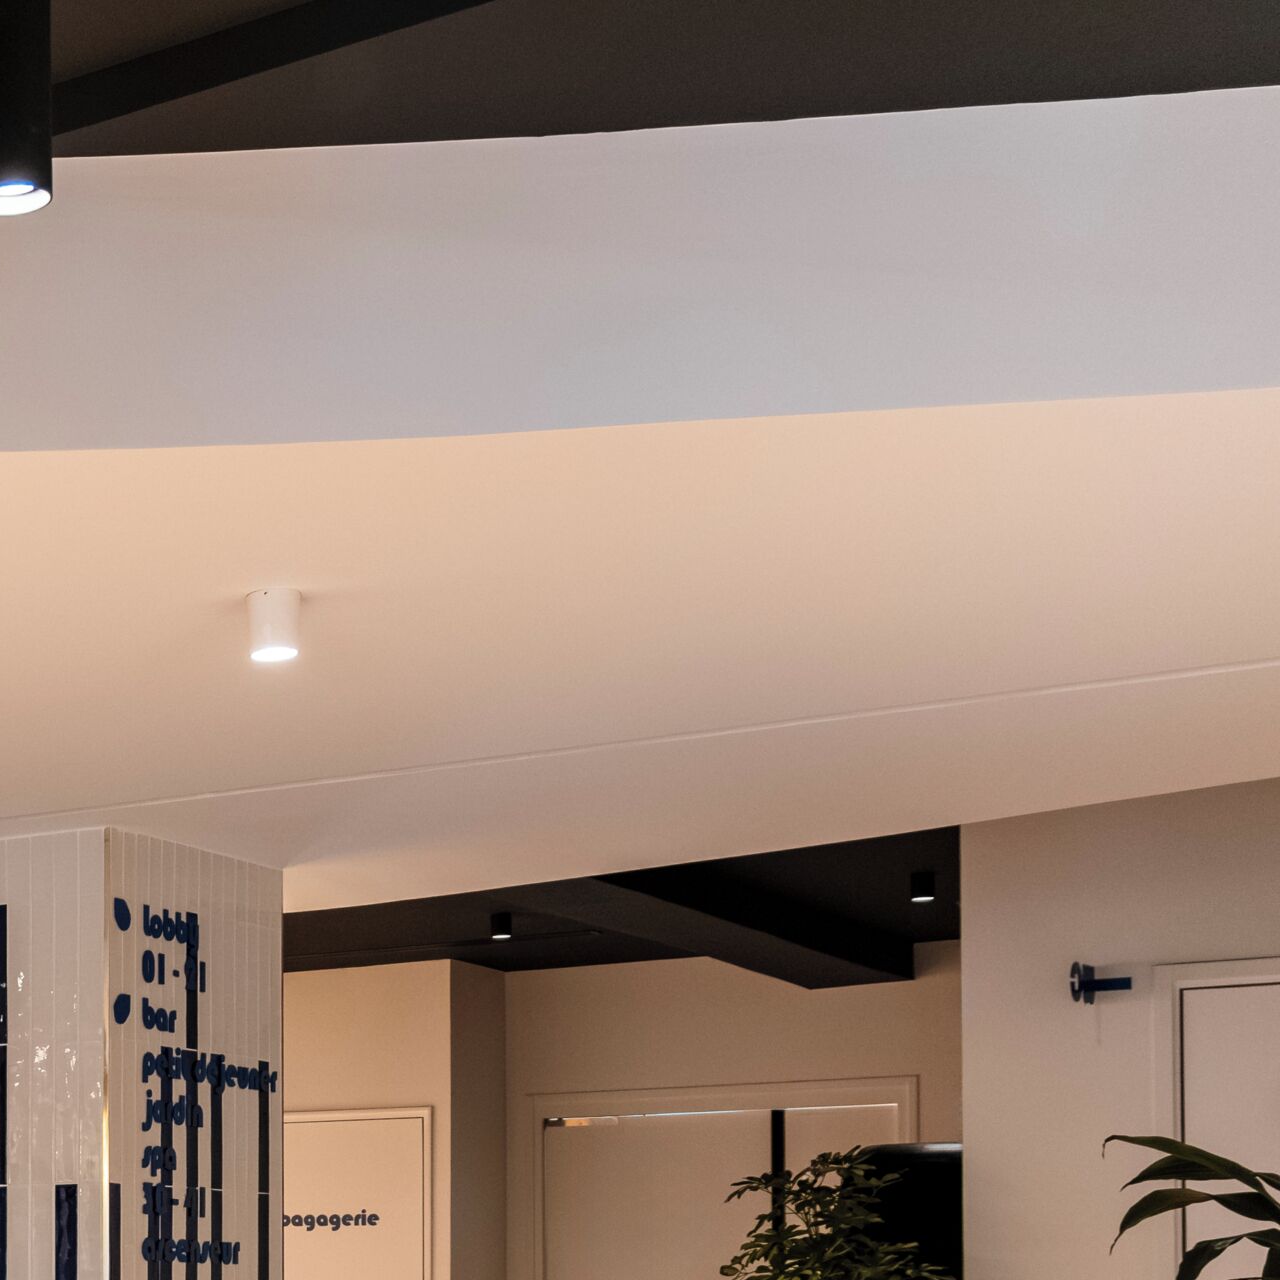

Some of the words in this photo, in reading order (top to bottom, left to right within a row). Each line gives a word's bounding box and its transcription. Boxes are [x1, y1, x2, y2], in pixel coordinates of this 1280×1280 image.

[143, 904, 199, 958] lobby
[142, 950, 166, 985] 01
[184, 955, 206, 993] 21
[142, 997, 177, 1033] bar
[142, 1046, 194, 1083] petit
[142, 1089, 204, 1131] jardin
[142, 1145, 177, 1177] spa
[142, 1236, 240, 1265] ascenseur
